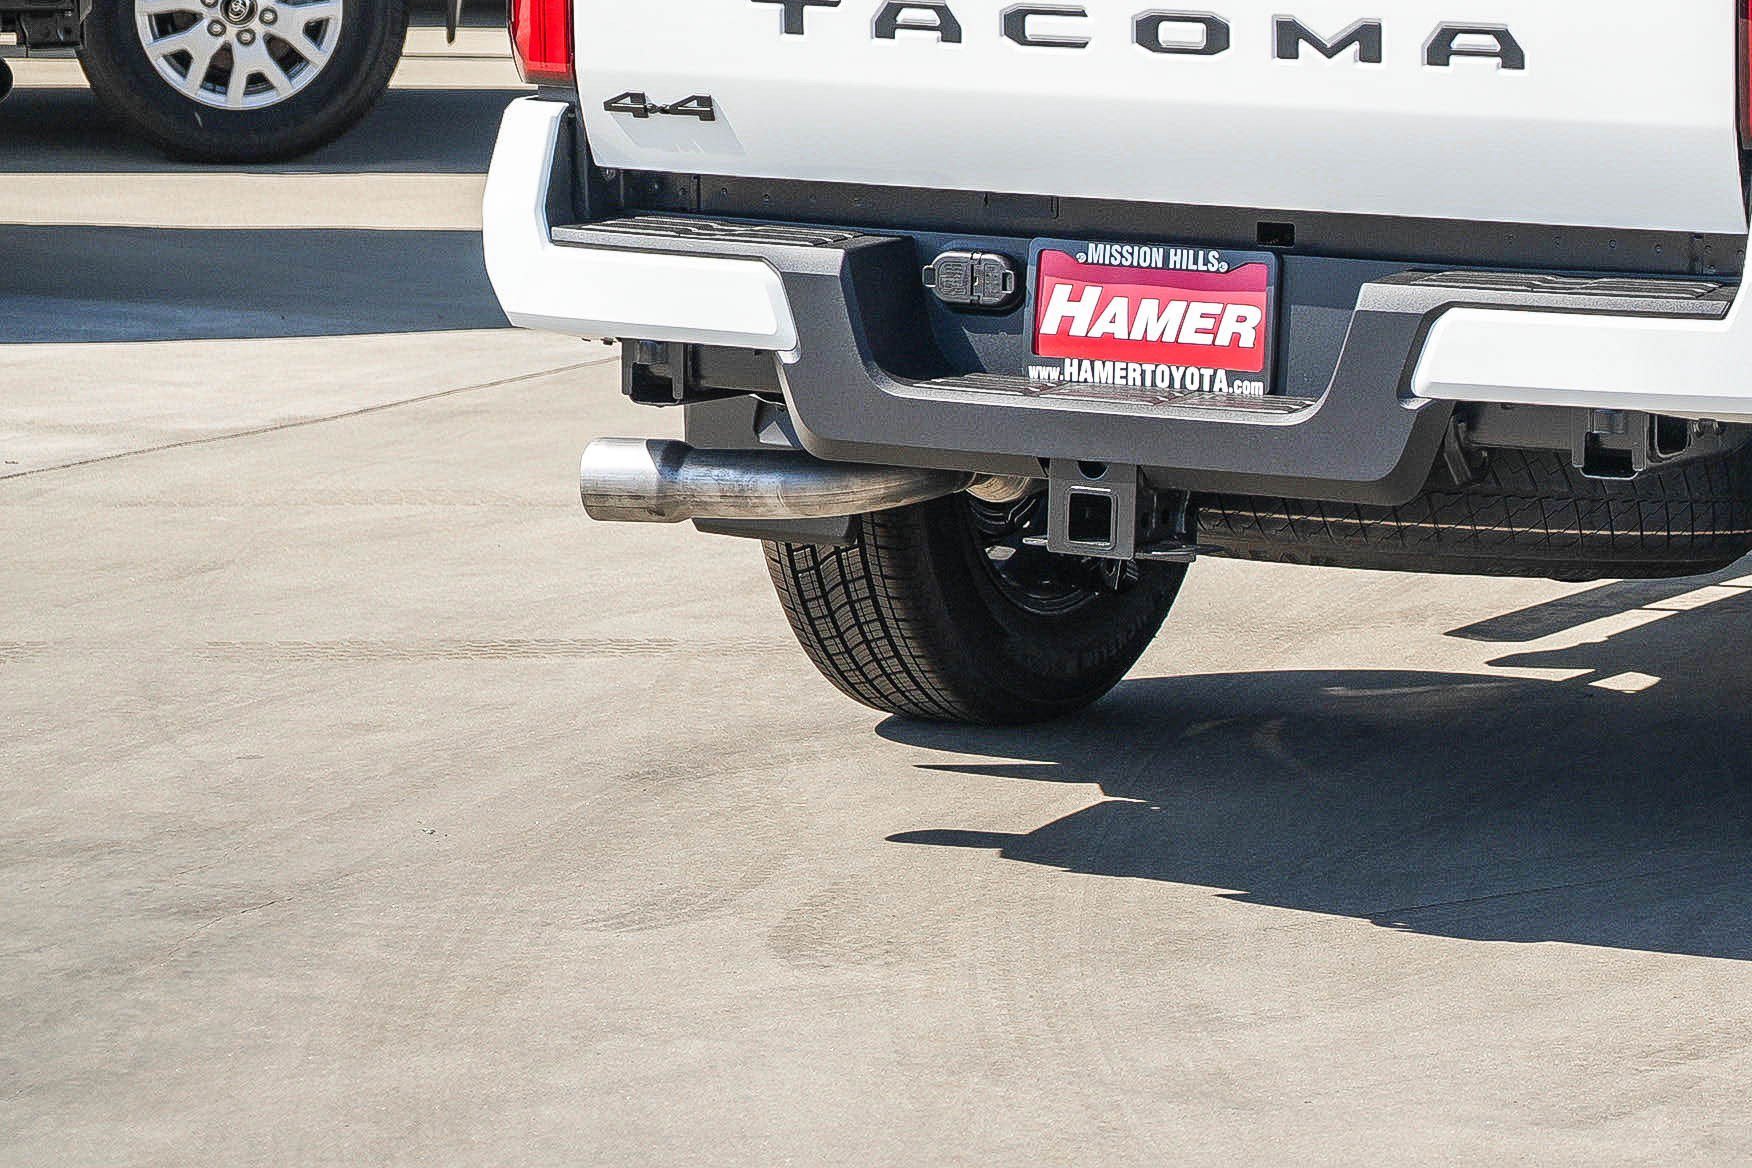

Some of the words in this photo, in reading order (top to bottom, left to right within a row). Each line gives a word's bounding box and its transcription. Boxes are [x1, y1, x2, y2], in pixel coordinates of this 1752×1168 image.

[1087, 242, 1164, 269] MISSION
[1168, 246, 1220, 272] HILLS
[1038, 282, 1263, 348] HAMER
[1028, 358, 1265, 397] www.HAMERTOYOTA.com
